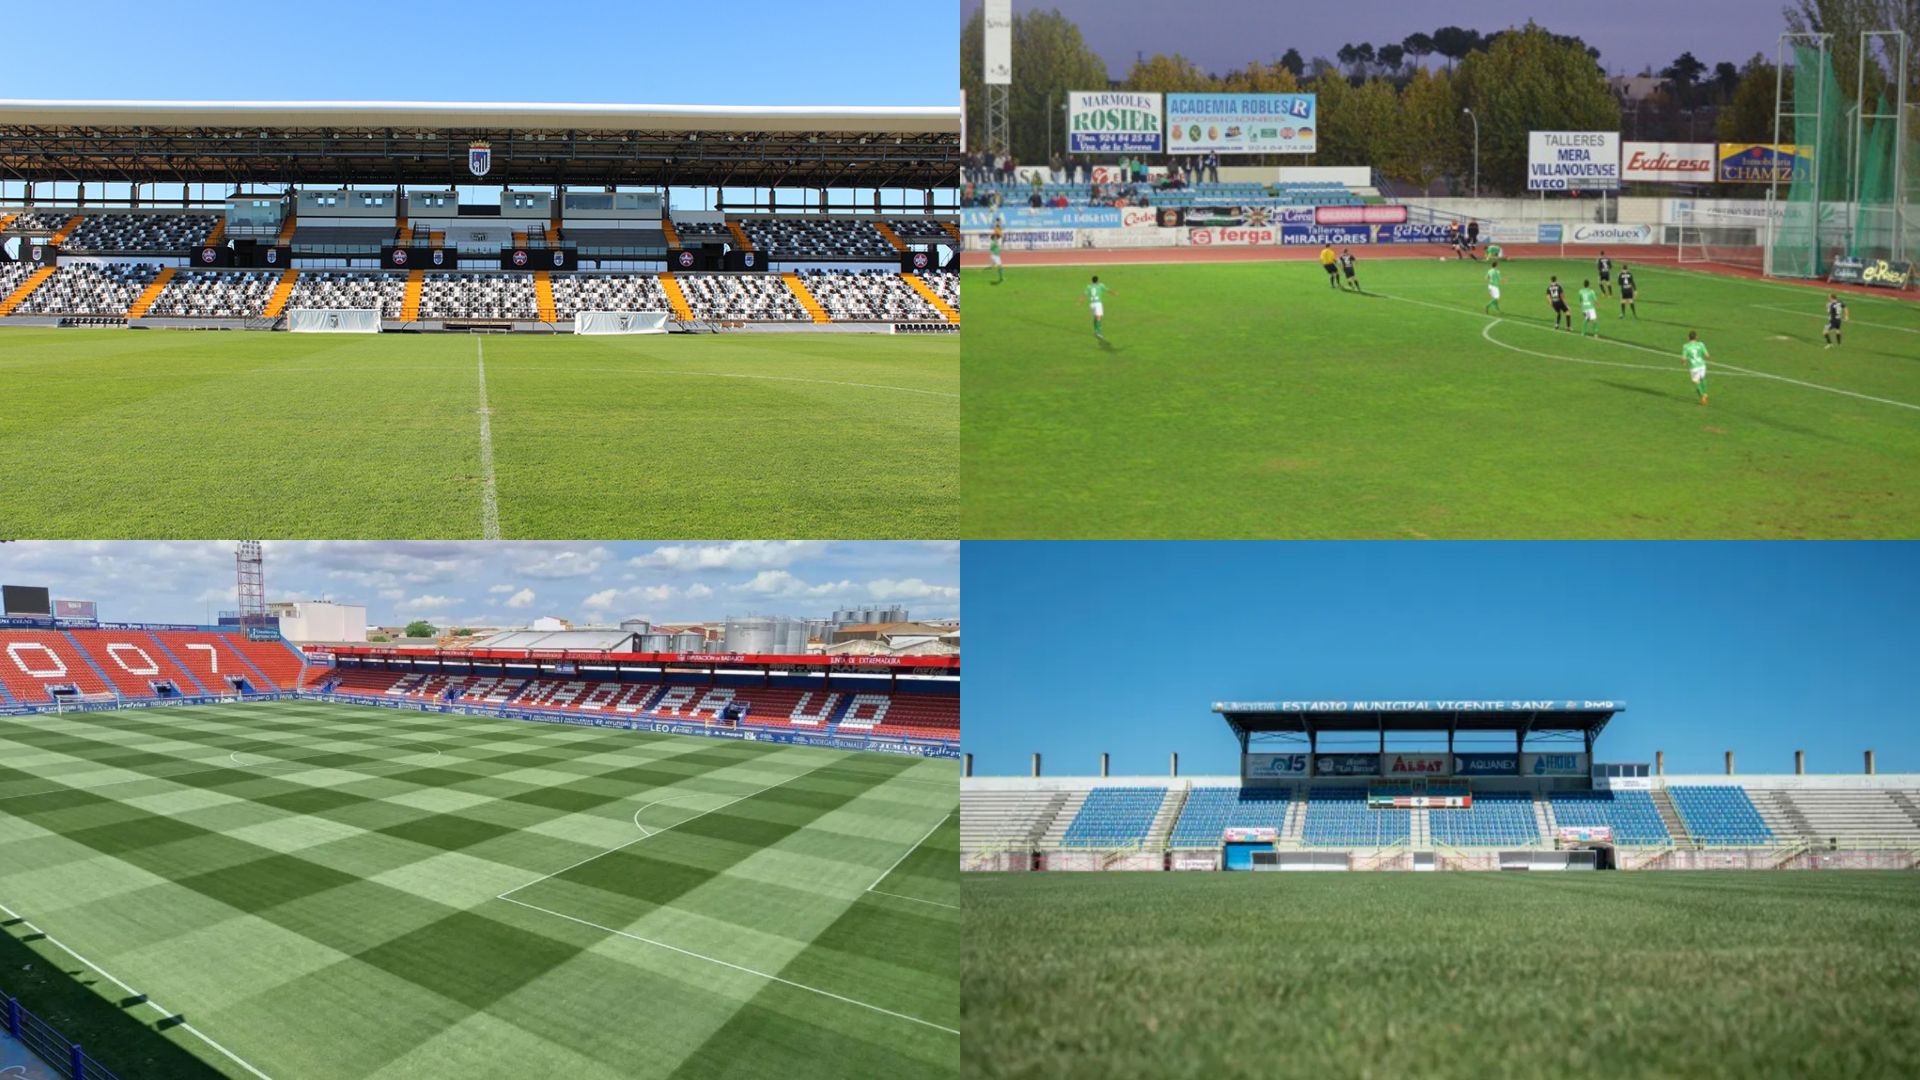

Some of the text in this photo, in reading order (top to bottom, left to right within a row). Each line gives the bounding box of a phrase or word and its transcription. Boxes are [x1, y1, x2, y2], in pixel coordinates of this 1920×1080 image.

[1082, 94, 1151, 109] MARMOLES
[1171, 99, 1236, 115] ACADEMIA
[1242, 99, 1289, 115] ROBLES
[1073, 108, 1158, 131] ROSIER
[1544, 134, 1605, 147] TALLERES
[1557, 149, 1590, 161] MERA
[1531, 163, 1616, 176] VILLANOVENSE
[1530, 179, 1565, 189] IVECO
[1219, 227, 1272, 245] ferga
[1308, 226, 1346, 235] Talleres
[1284, 234, 1367, 244] MIRAFLORES
[859, 656, 901, 665] EXTREMADURA
[1282, 701, 1348, 711] ESTADIO
[1352, 701, 1433, 711] MUNICIPAL
[1436, 701, 1505, 711] VICENTE
[1511, 700, 1554, 711] SANZ
[650, 723, 670, 733] LEO
[1469, 759, 1516, 769] AQUANEX
